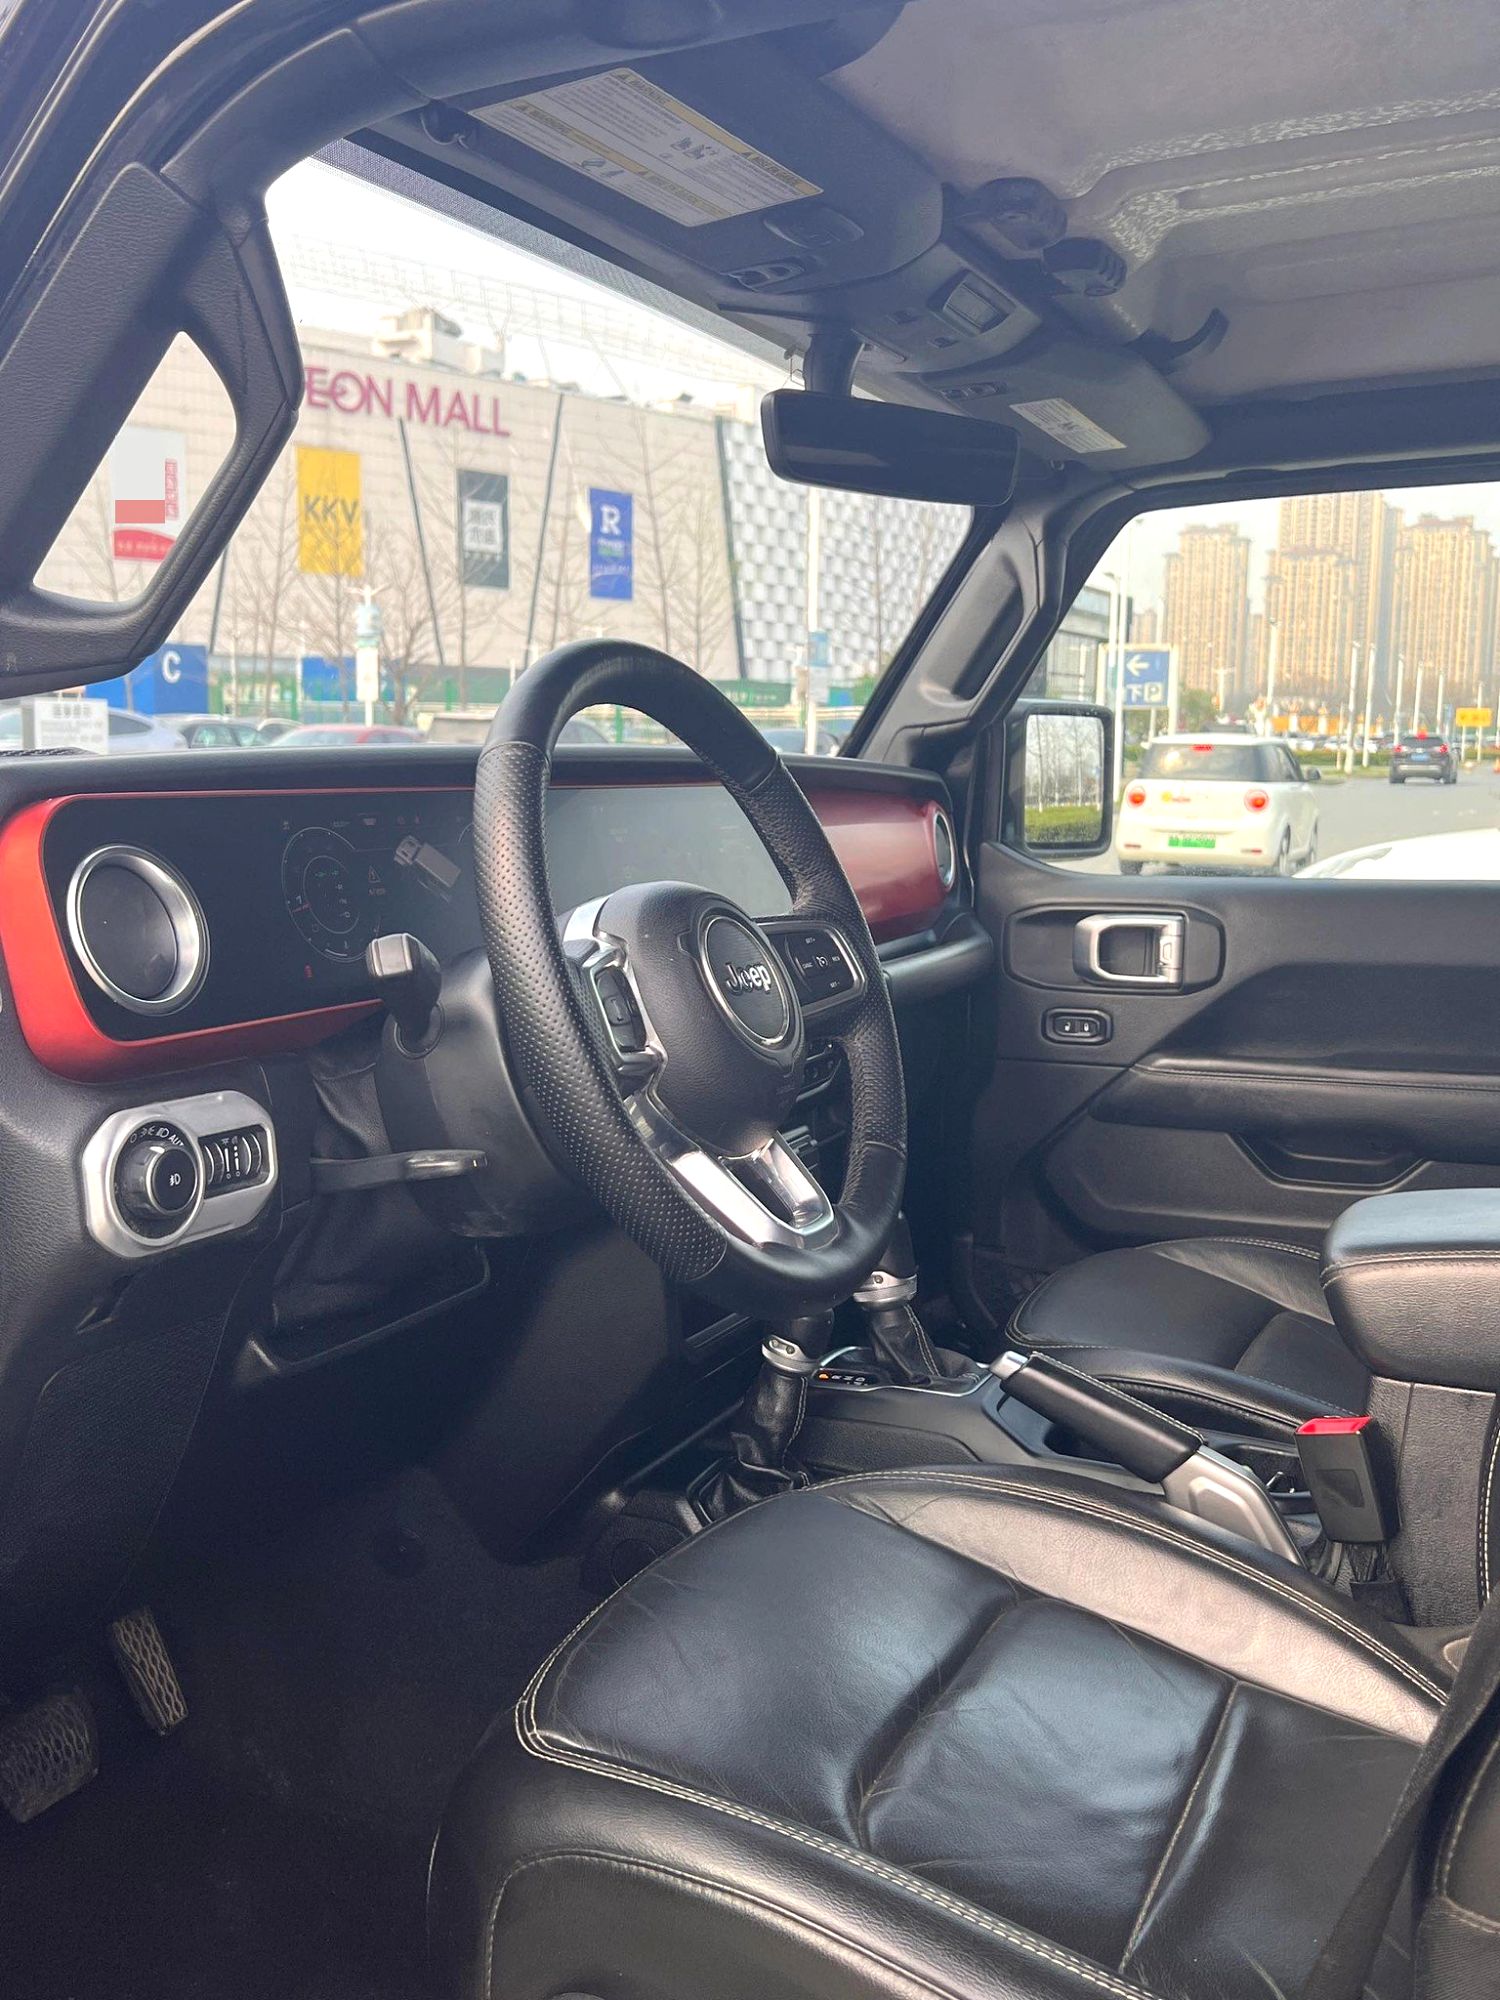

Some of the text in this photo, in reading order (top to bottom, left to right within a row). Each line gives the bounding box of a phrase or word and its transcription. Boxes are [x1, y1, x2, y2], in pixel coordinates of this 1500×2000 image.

[406, 381, 511, 437] MALL
[303, 494, 361, 525] KKV
[600, 504, 622, 535] R
[162, 651, 182, 683] C
[725, 962, 772, 994] Jeep
